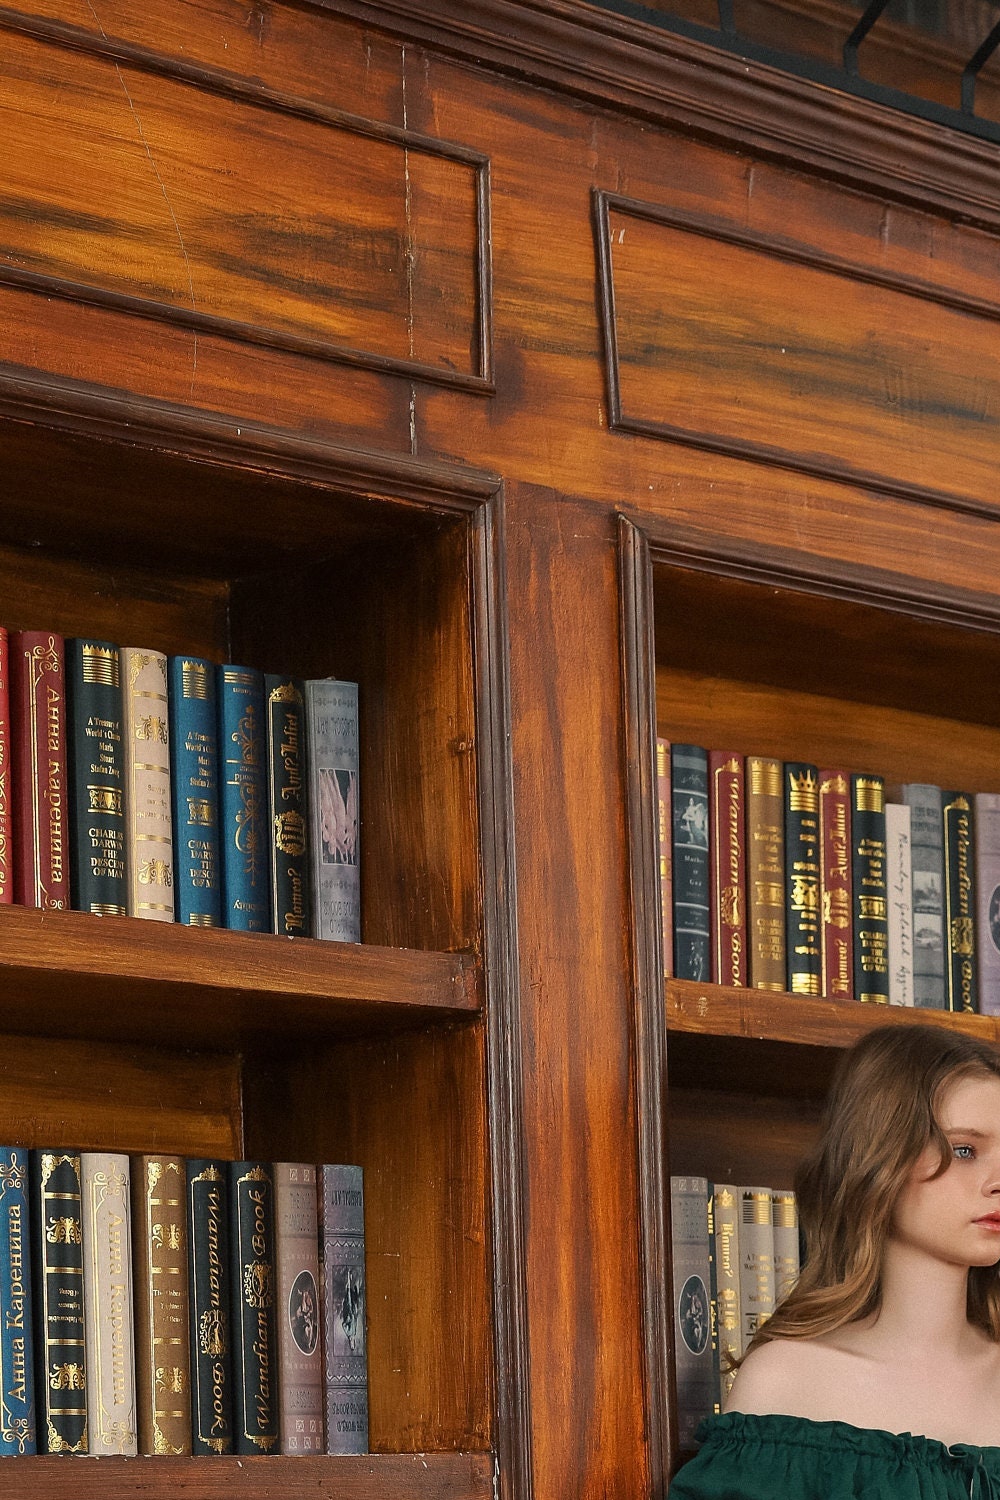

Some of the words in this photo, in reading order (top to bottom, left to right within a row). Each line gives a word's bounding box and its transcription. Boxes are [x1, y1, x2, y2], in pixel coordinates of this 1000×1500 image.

[46, 685, 60, 752] Анна
[44, 758, 63, 883] Каренина
[108, 1210, 124, 1276] Анна
[207, 1187, 223, 1310] Wandian
[249, 1189, 266, 1256] Book
[6, 1204, 26, 1330] Каренина
[8, 1337, 26, 1404] Анна
[210, 1362, 228, 1436] Book
[254, 1311, 270, 1430] Wandian
